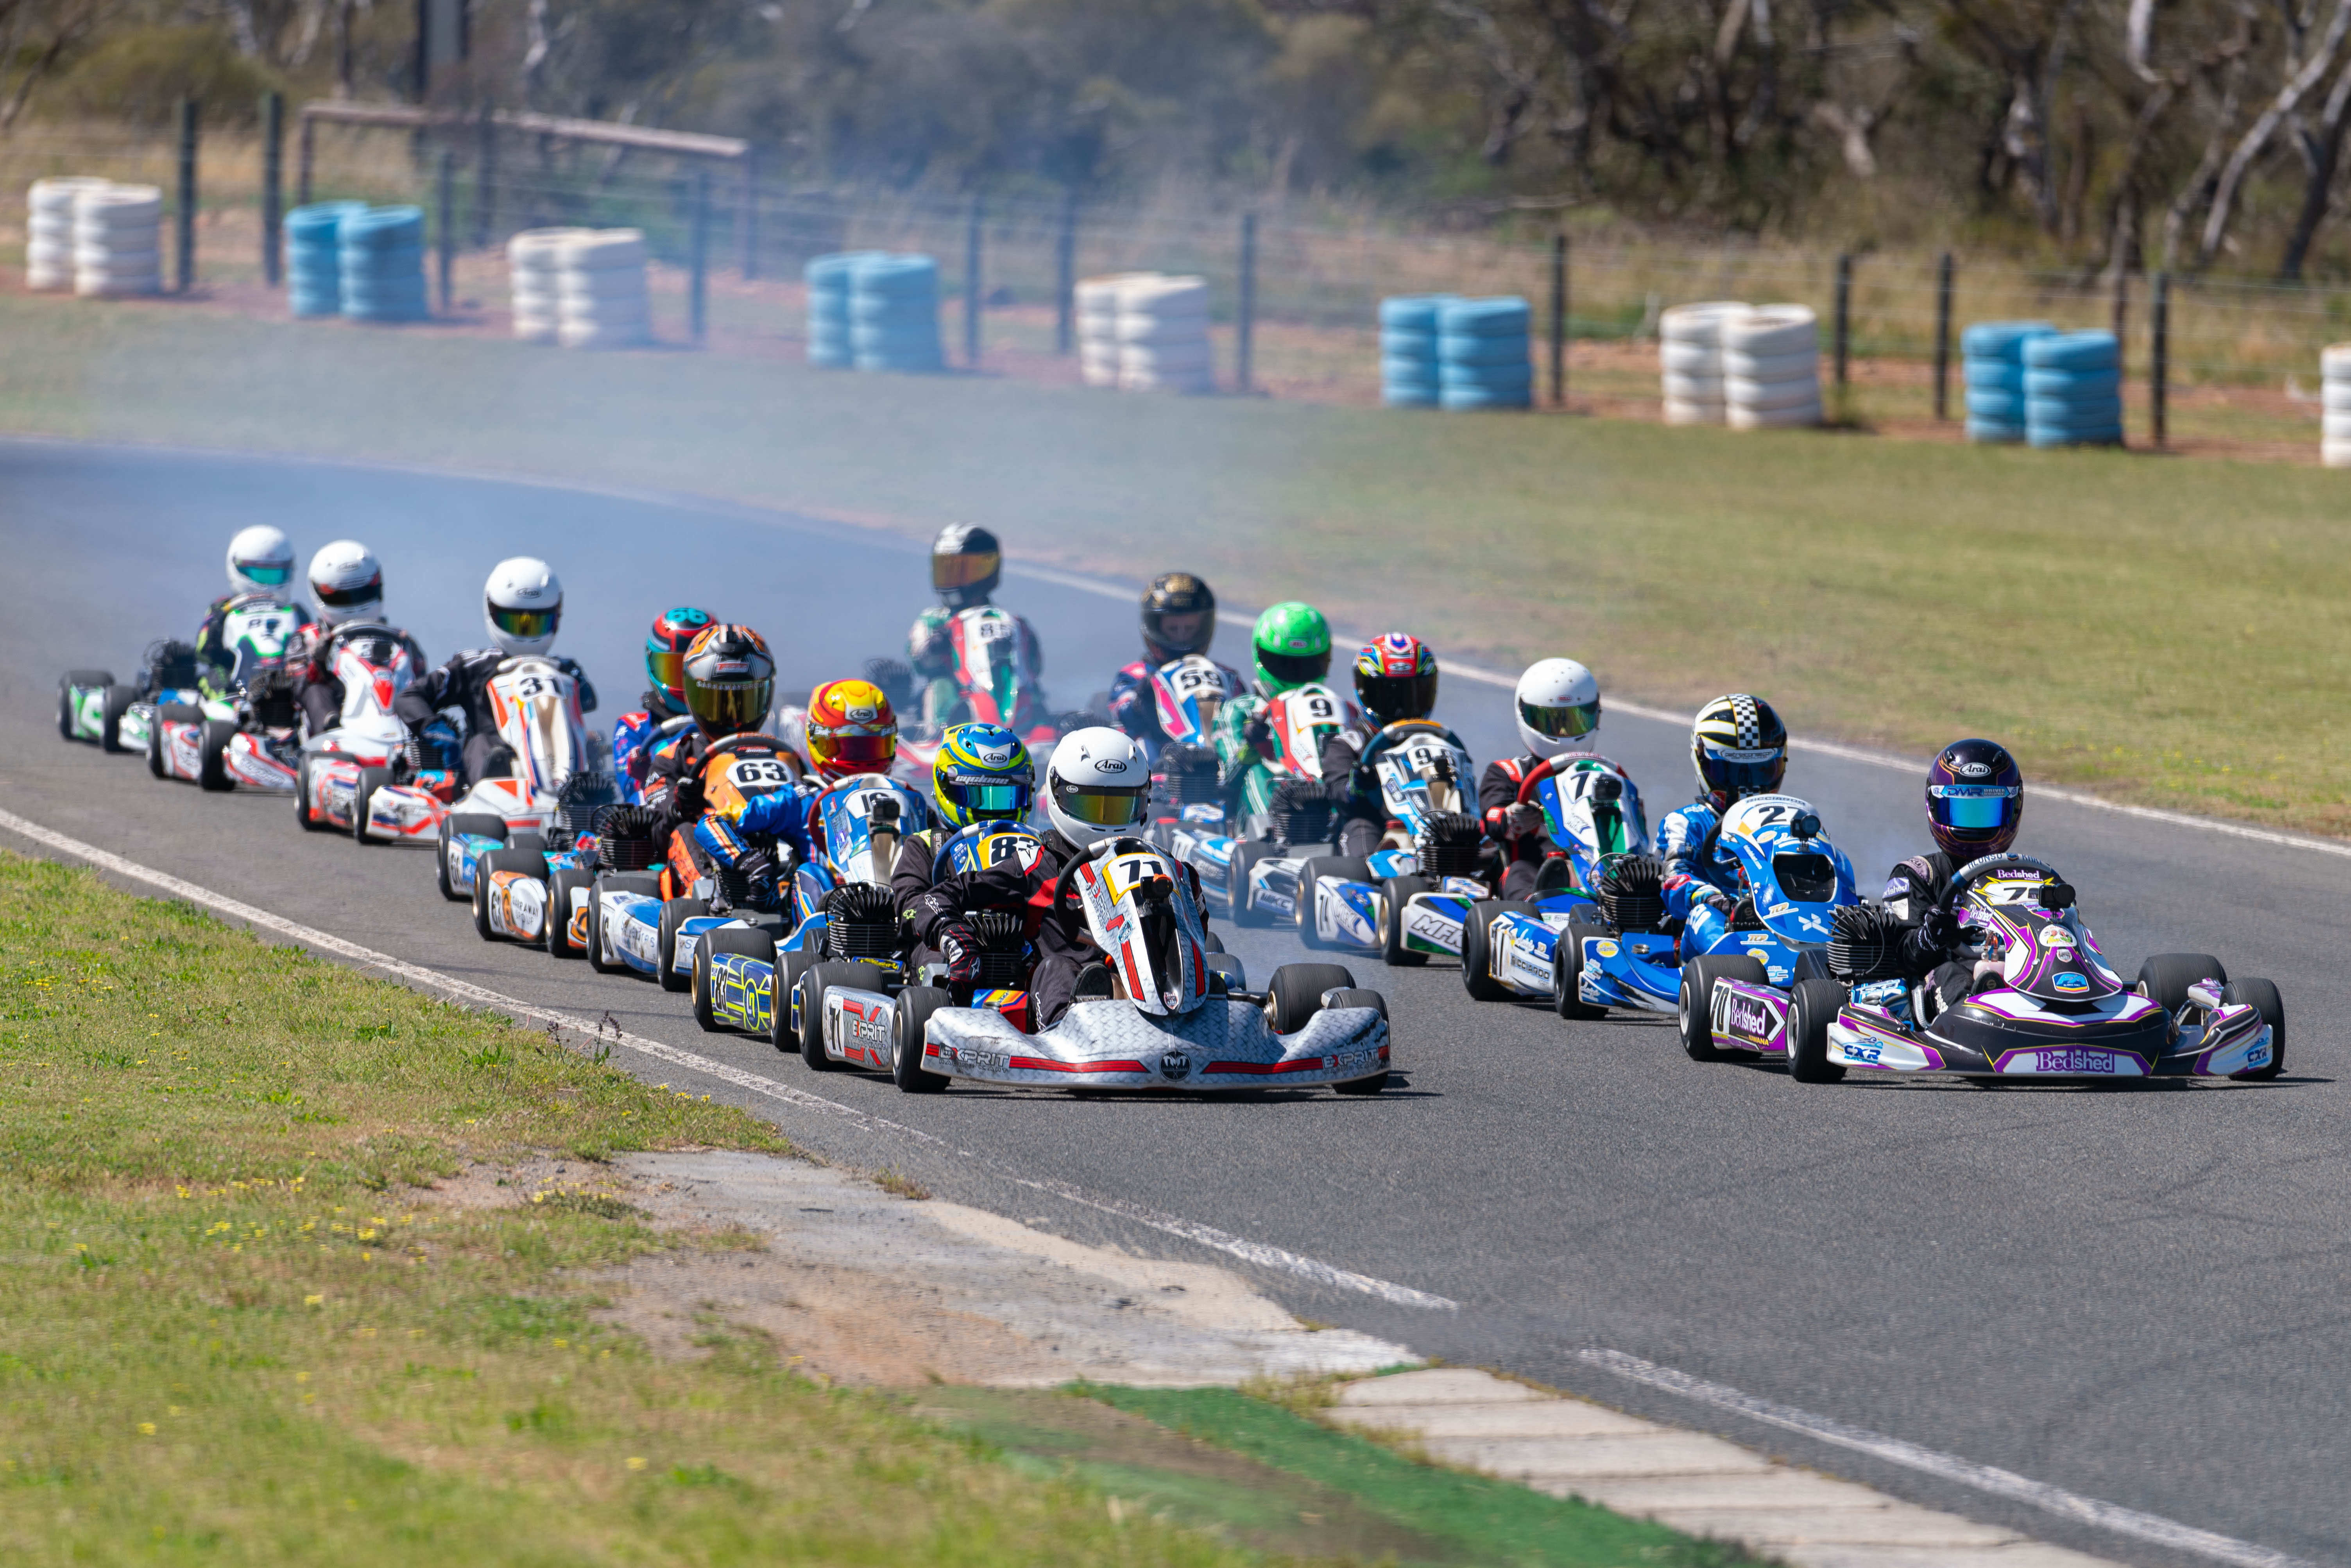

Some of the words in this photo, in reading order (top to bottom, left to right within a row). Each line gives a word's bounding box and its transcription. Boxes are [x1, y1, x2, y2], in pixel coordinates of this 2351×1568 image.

[519, 677, 562, 698] 31
[1179, 669, 1223, 689] 59
[742, 761, 783, 780] 63
[1097, 760, 1124, 770] Arai
[955, 774, 1010, 785] cyclone
[1946, 788, 1984, 797] DMR
[1997, 869, 2040, 879] Bedshed
[1970, 904, 1994, 922] Bedshed
[715, 966, 729, 1012] 83
[1710, 984, 1730, 1033] 70
[1731, 997, 1766, 1036] Bedshed
[852, 1018, 886, 1043] EXPRIT
[939, 1042, 1010, 1067] EXPRIT
[1163, 1055, 1187, 1067] TMT
[1323, 1048, 1377, 1069] EXPRIT
[1844, 1045, 1881, 1060] CXR
[2038, 1051, 2113, 1071] Bedshed
[978, 1064, 1008, 1074] KART
